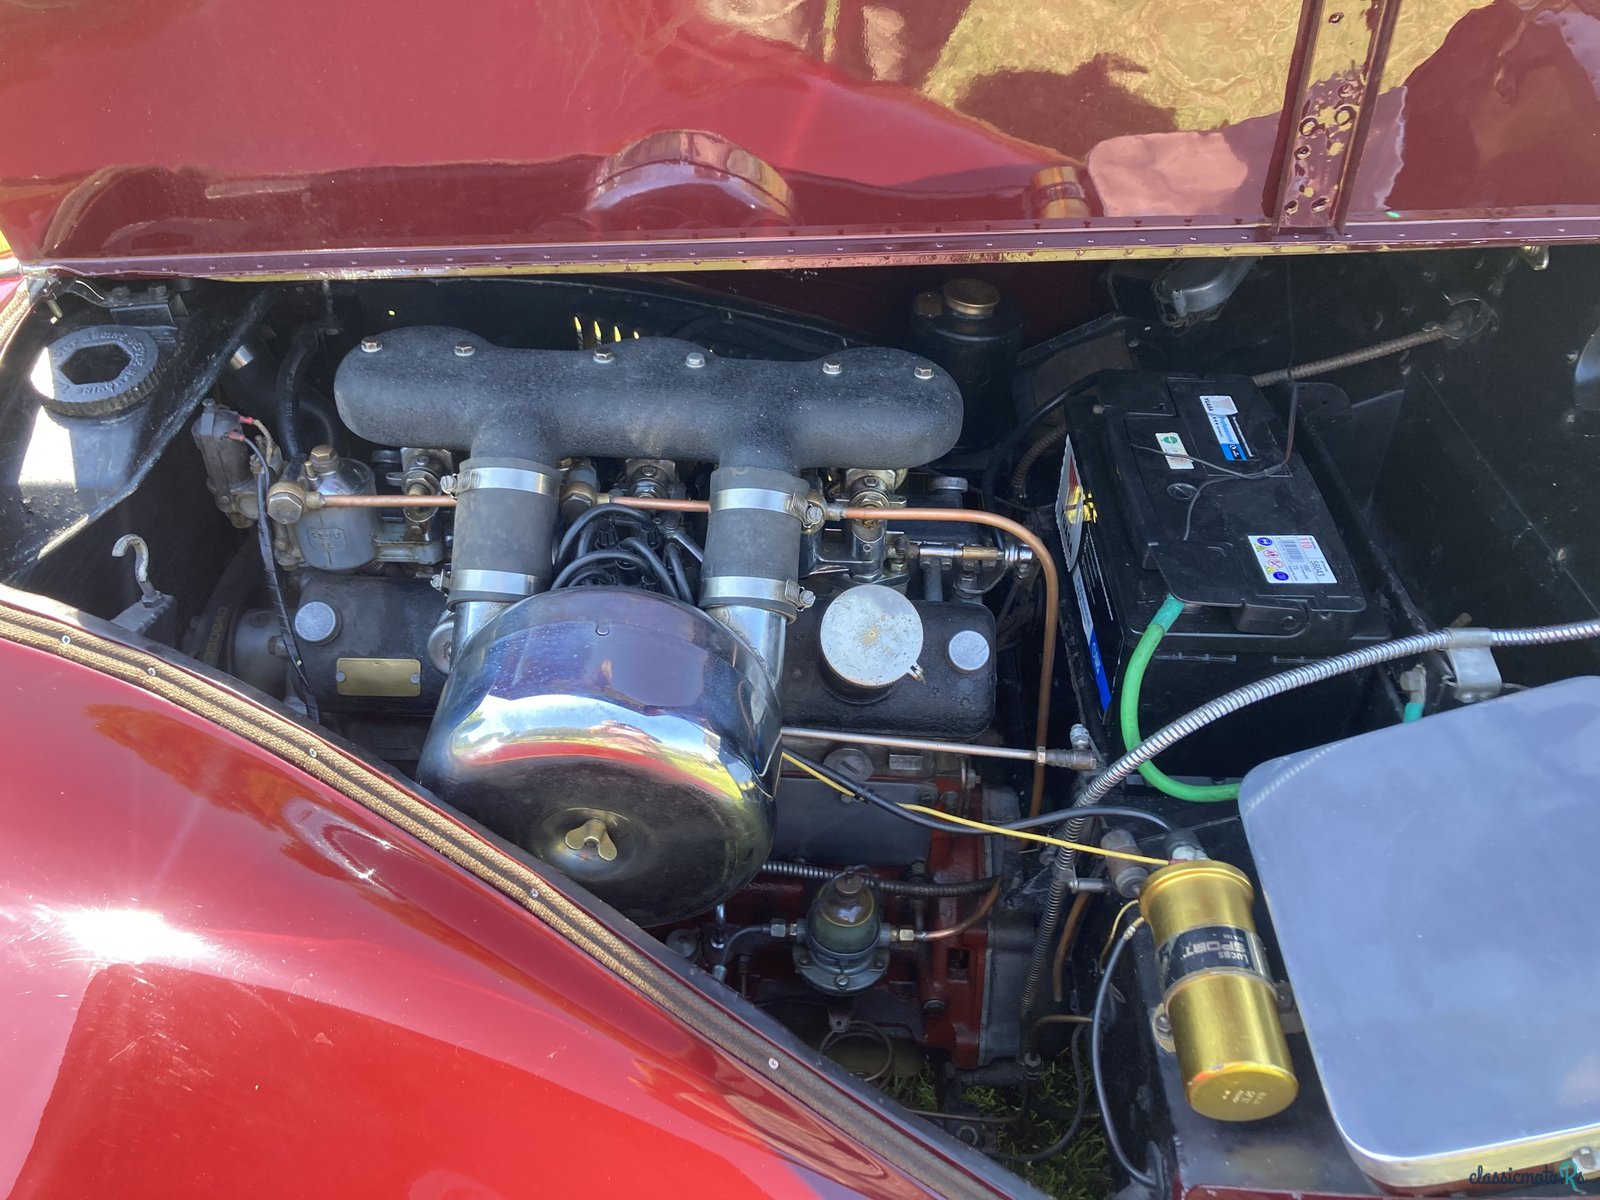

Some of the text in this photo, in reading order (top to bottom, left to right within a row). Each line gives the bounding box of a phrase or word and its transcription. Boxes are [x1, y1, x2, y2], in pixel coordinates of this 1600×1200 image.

[1203, 397, 1215, 412] YUASA
[1299, 537, 1313, 548] 110
[1183, 940, 1246, 959] SPORT
